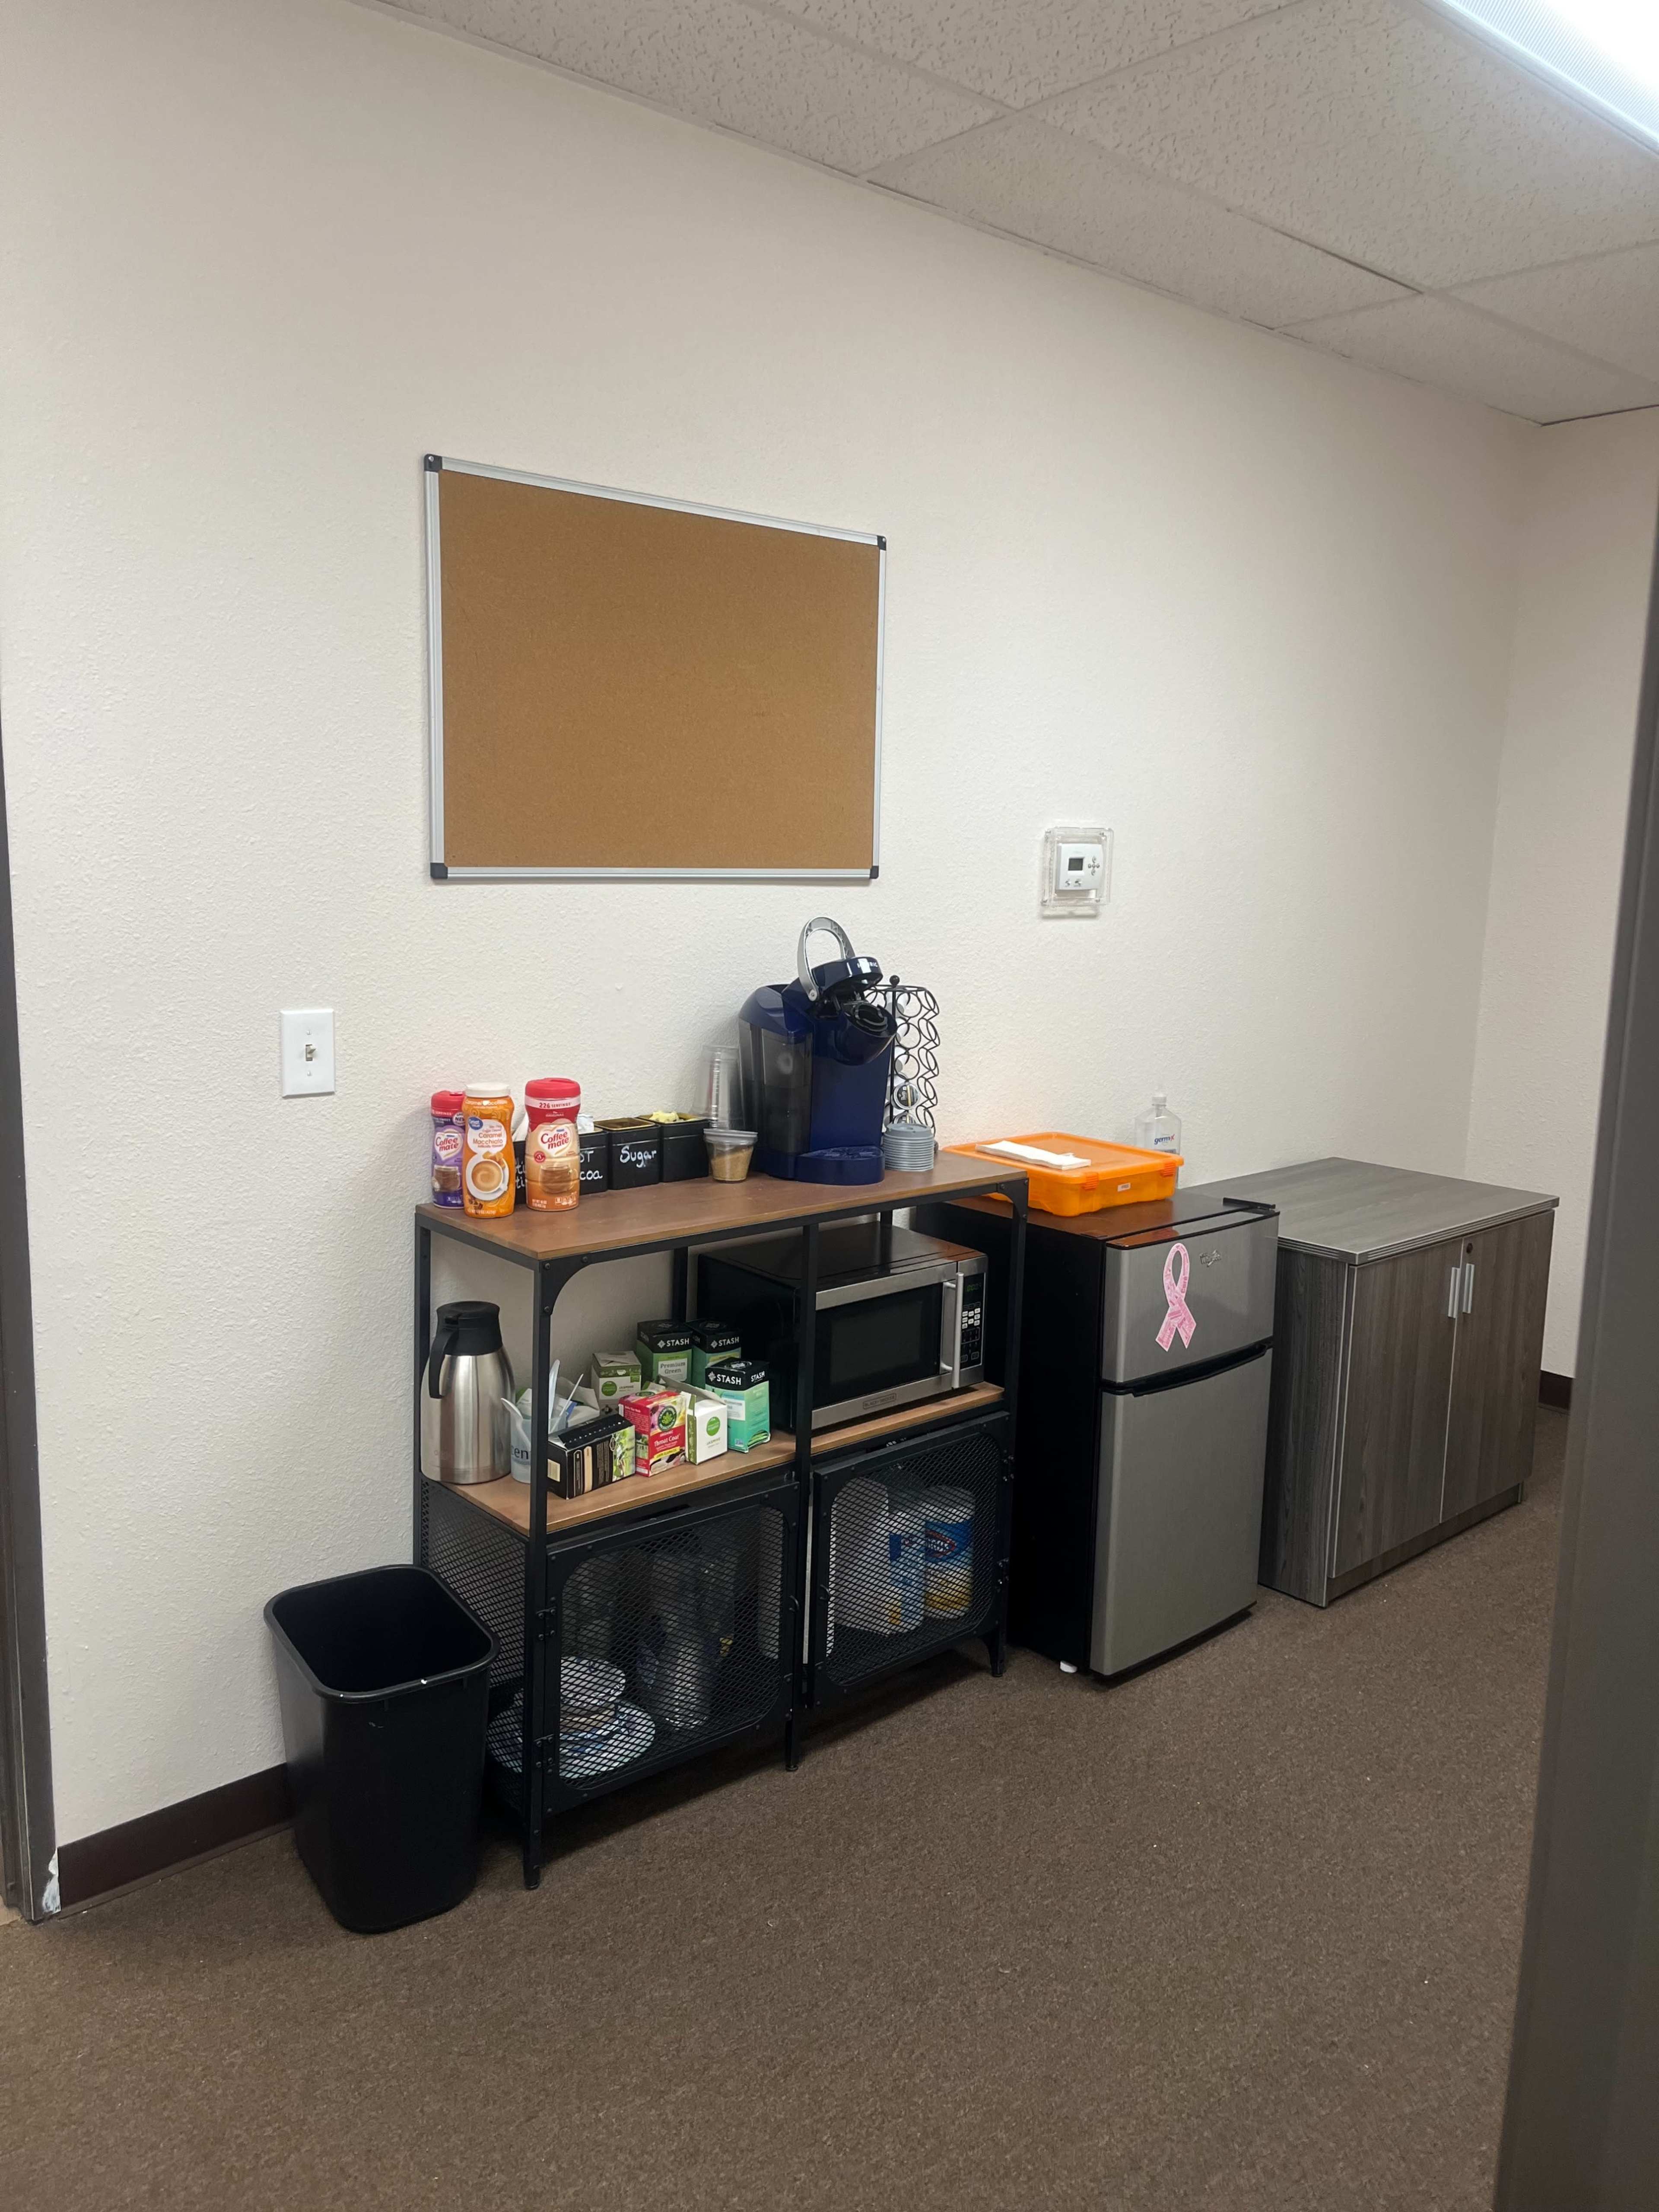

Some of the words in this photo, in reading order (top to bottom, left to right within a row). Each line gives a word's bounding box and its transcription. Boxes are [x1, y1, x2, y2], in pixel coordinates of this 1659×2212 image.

[435, 1136, 458, 1146] Coffee
[540, 1131, 568, 1144] Coffee
[439, 1143, 459, 1151] mate
[548, 1137, 569, 1150] mate
[620, 1145, 657, 1168] Sugar
[580, 1170, 603, 1180] coa
[666, 1338, 690, 1347] STASH
[718, 1336, 739, 1347] STASH
[716, 1374, 742, 1386] STASH
[750, 1371, 765, 1382] STASH
[654, 1437, 668, 1447] Throat
[668, 1434, 680, 1442] Coat
